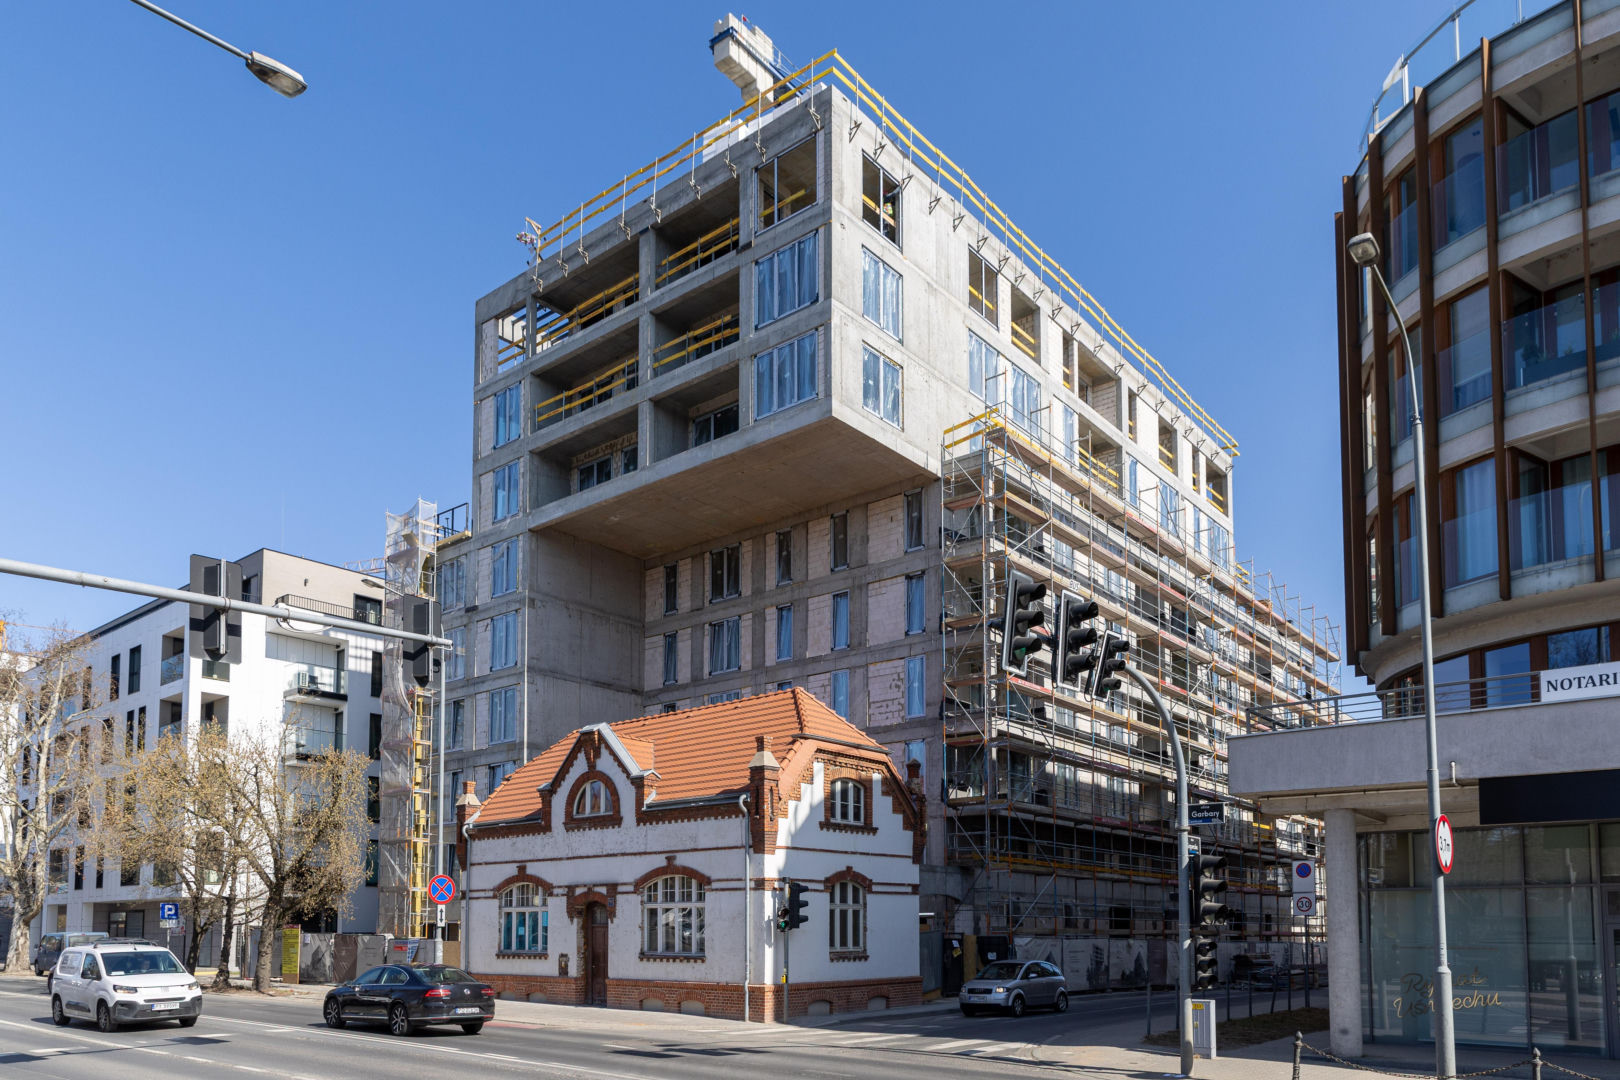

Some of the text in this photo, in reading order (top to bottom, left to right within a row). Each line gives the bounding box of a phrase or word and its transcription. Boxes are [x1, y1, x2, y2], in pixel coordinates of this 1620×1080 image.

[1546, 672, 1620, 692] NOTARI
[164, 904, 176, 918] P
[1300, 900, 1310, 908] 30
